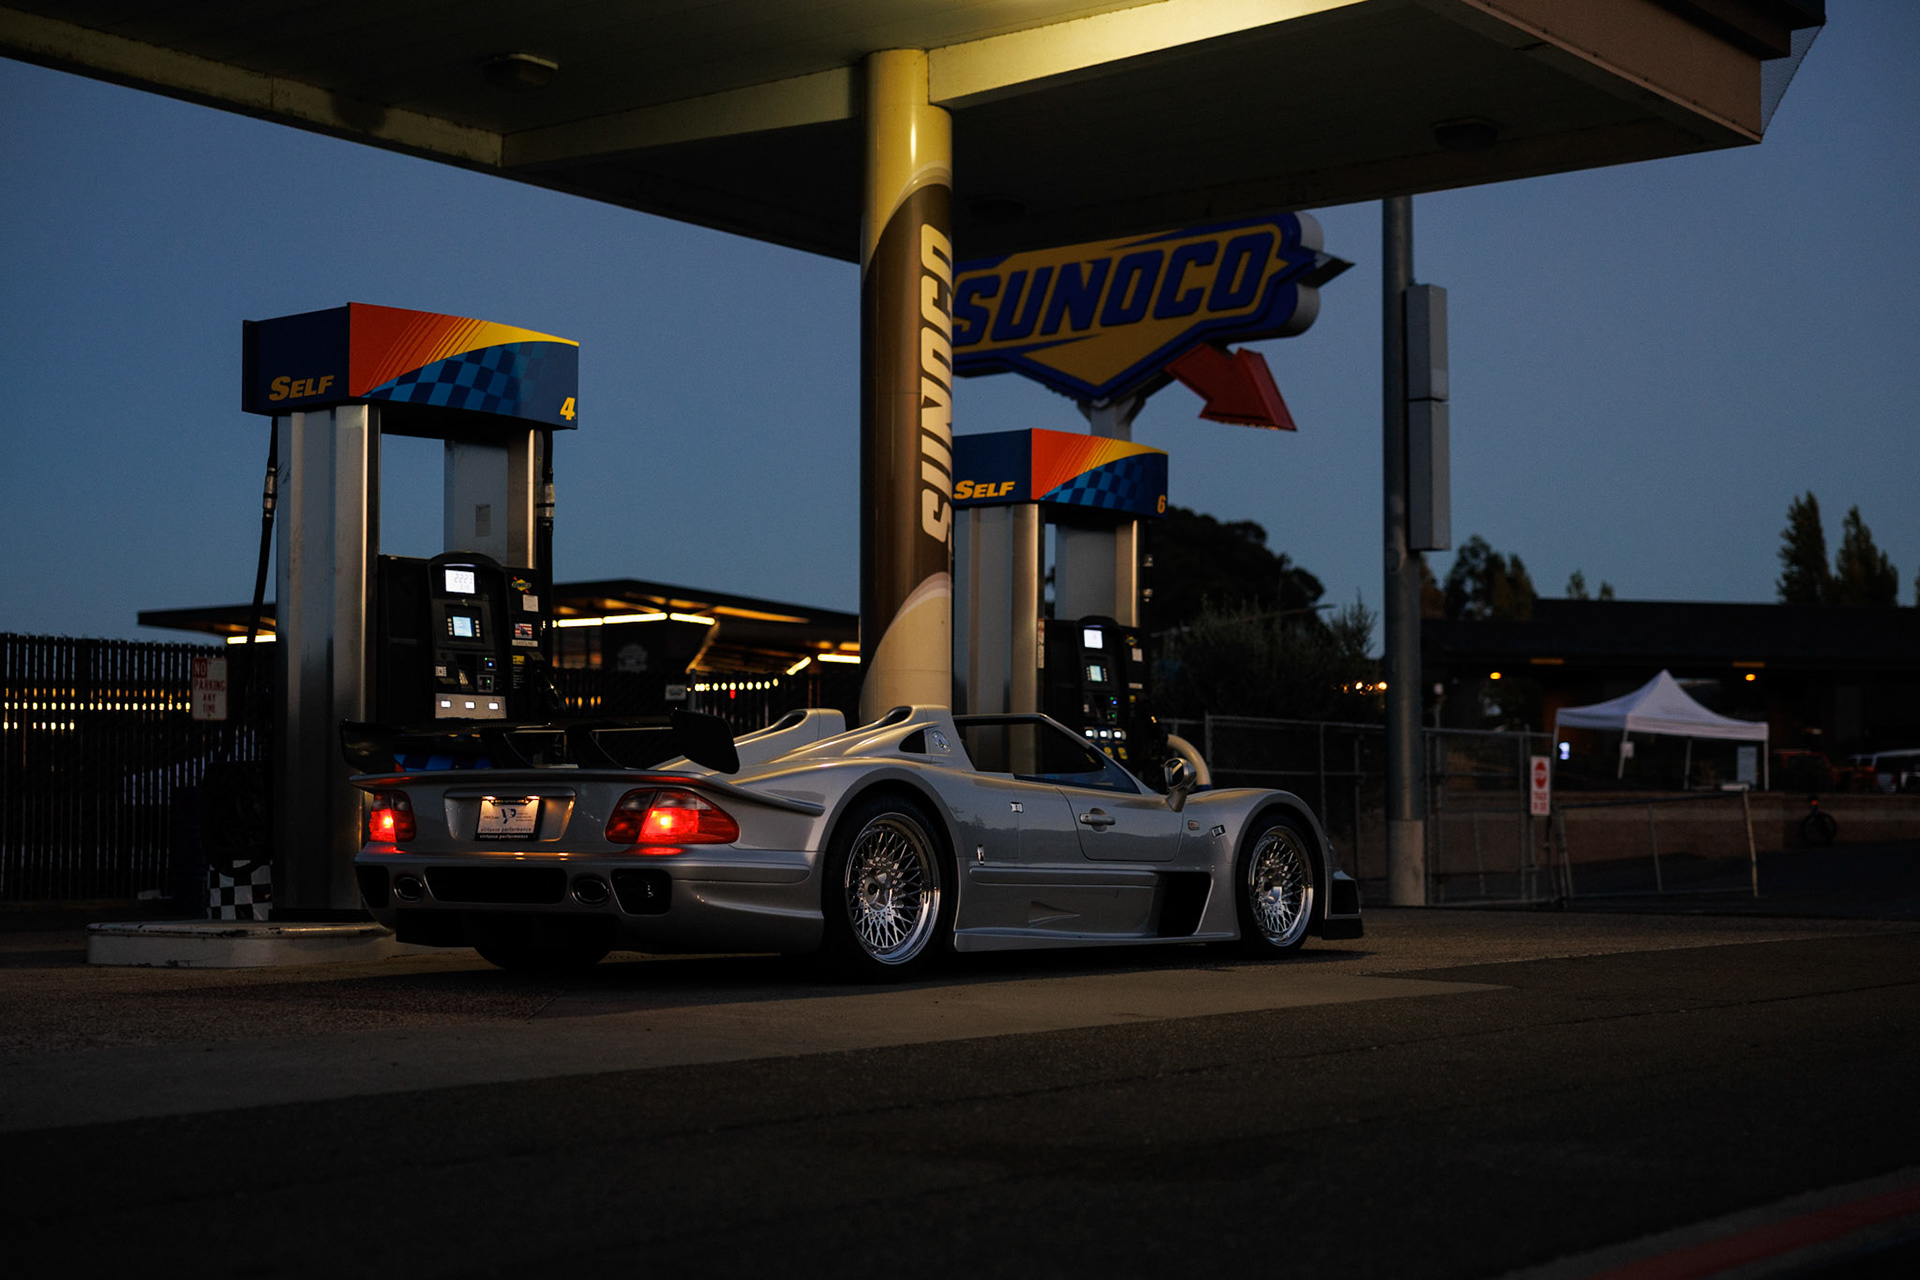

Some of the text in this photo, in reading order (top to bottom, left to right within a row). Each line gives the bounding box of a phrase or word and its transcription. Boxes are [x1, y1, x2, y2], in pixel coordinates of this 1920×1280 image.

[953, 231, 1275, 346] SUNOCO
[268, 374, 335, 402] SELF
[920, 222, 953, 545] SUNOCO
[559, 396, 577, 421] 4
[953, 480, 1016, 501] SELF
[1156, 494, 1167, 515] 6
[193, 661, 207, 677] NO
[194, 679, 226, 692] PARKING
[203, 693, 216, 702] ANY
[202, 704, 216, 713] TIME
